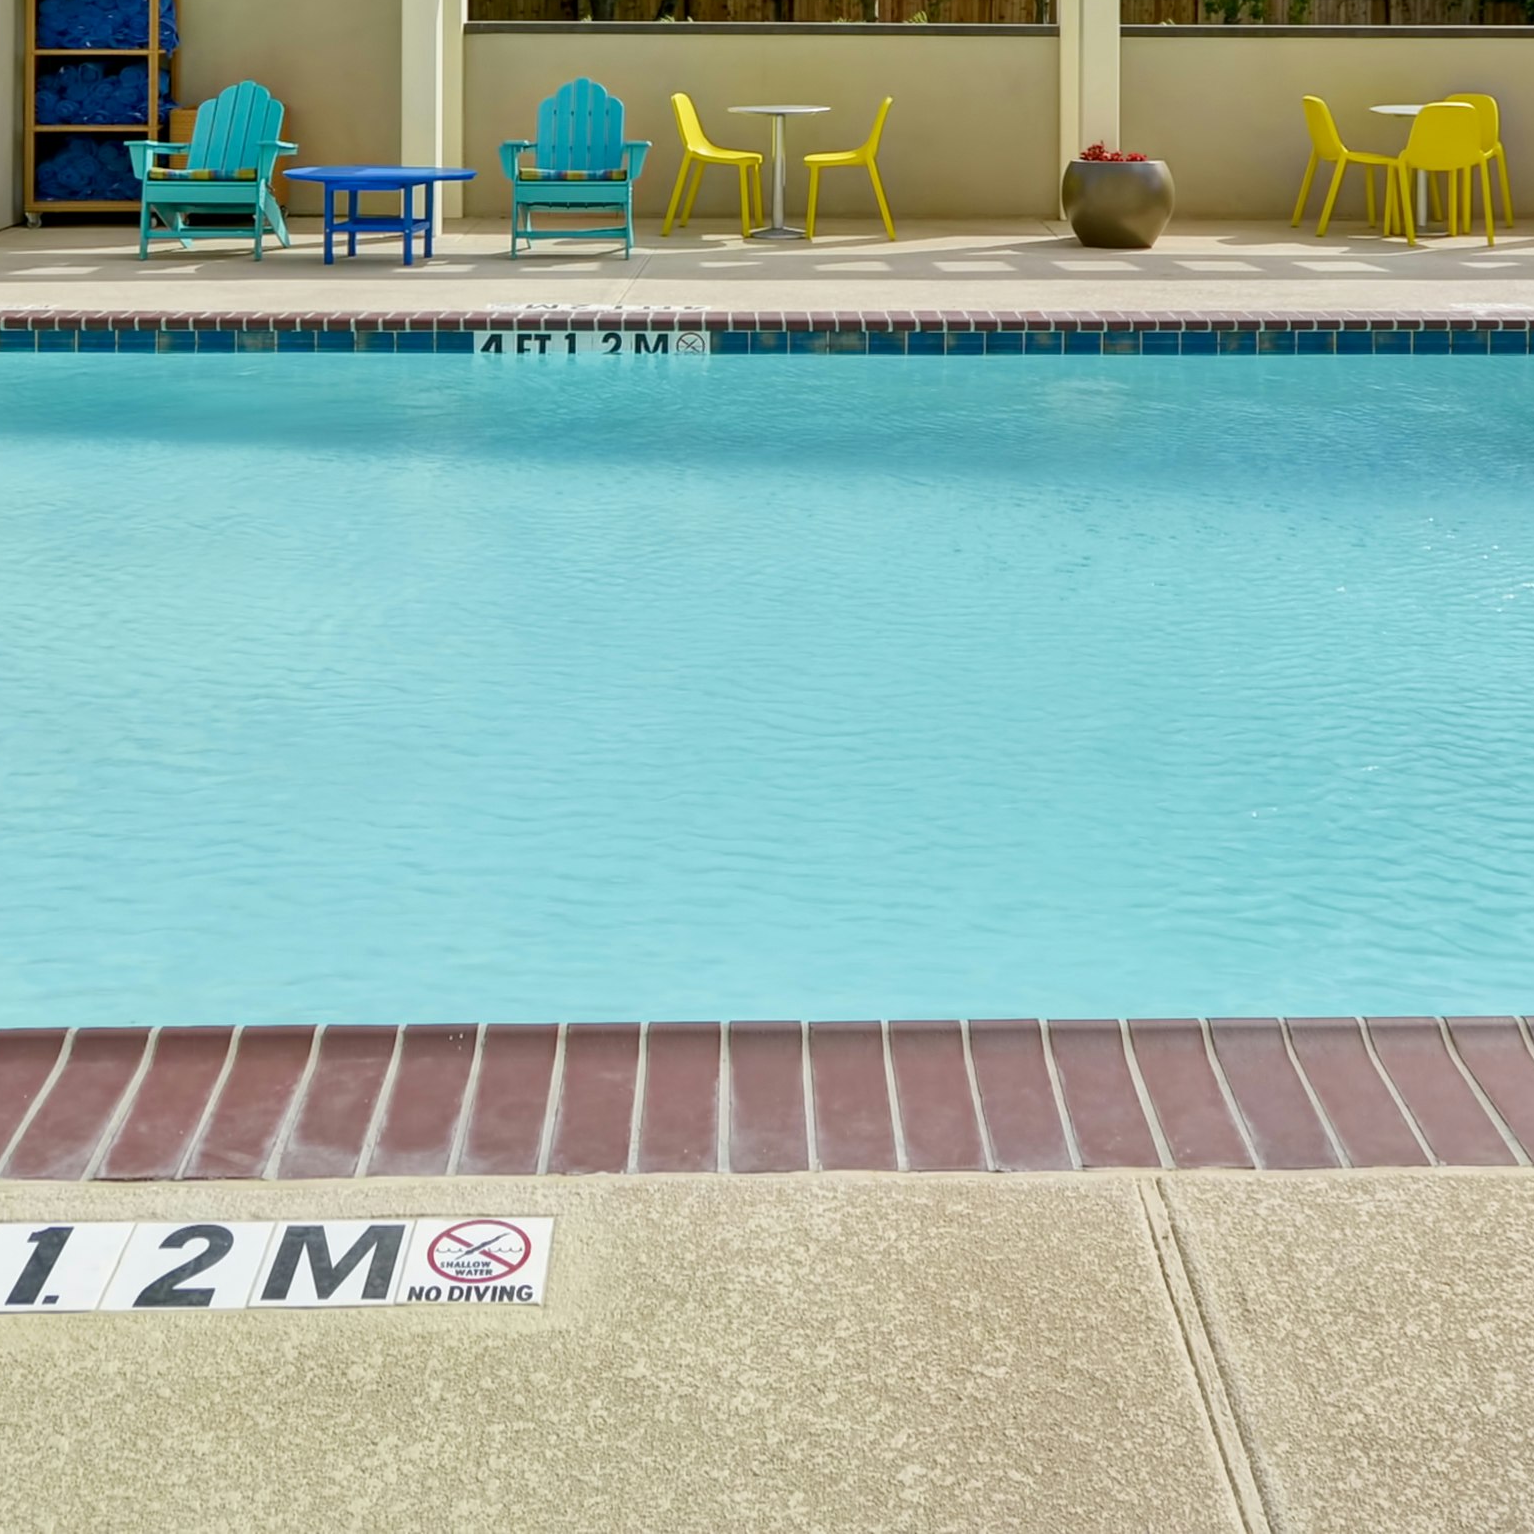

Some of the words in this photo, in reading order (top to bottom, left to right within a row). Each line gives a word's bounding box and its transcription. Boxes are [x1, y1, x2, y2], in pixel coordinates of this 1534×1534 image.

[634, 333, 669, 354] M
[131, 1224, 235, 1308] 2
[260, 1224, 407, 1301] M
[440, 1261, 492, 1269] SHALLOW
[454, 1268, 493, 1276] WATER
[407, 1285, 442, 1302] NO
[447, 1285, 534, 1302] DIVING
